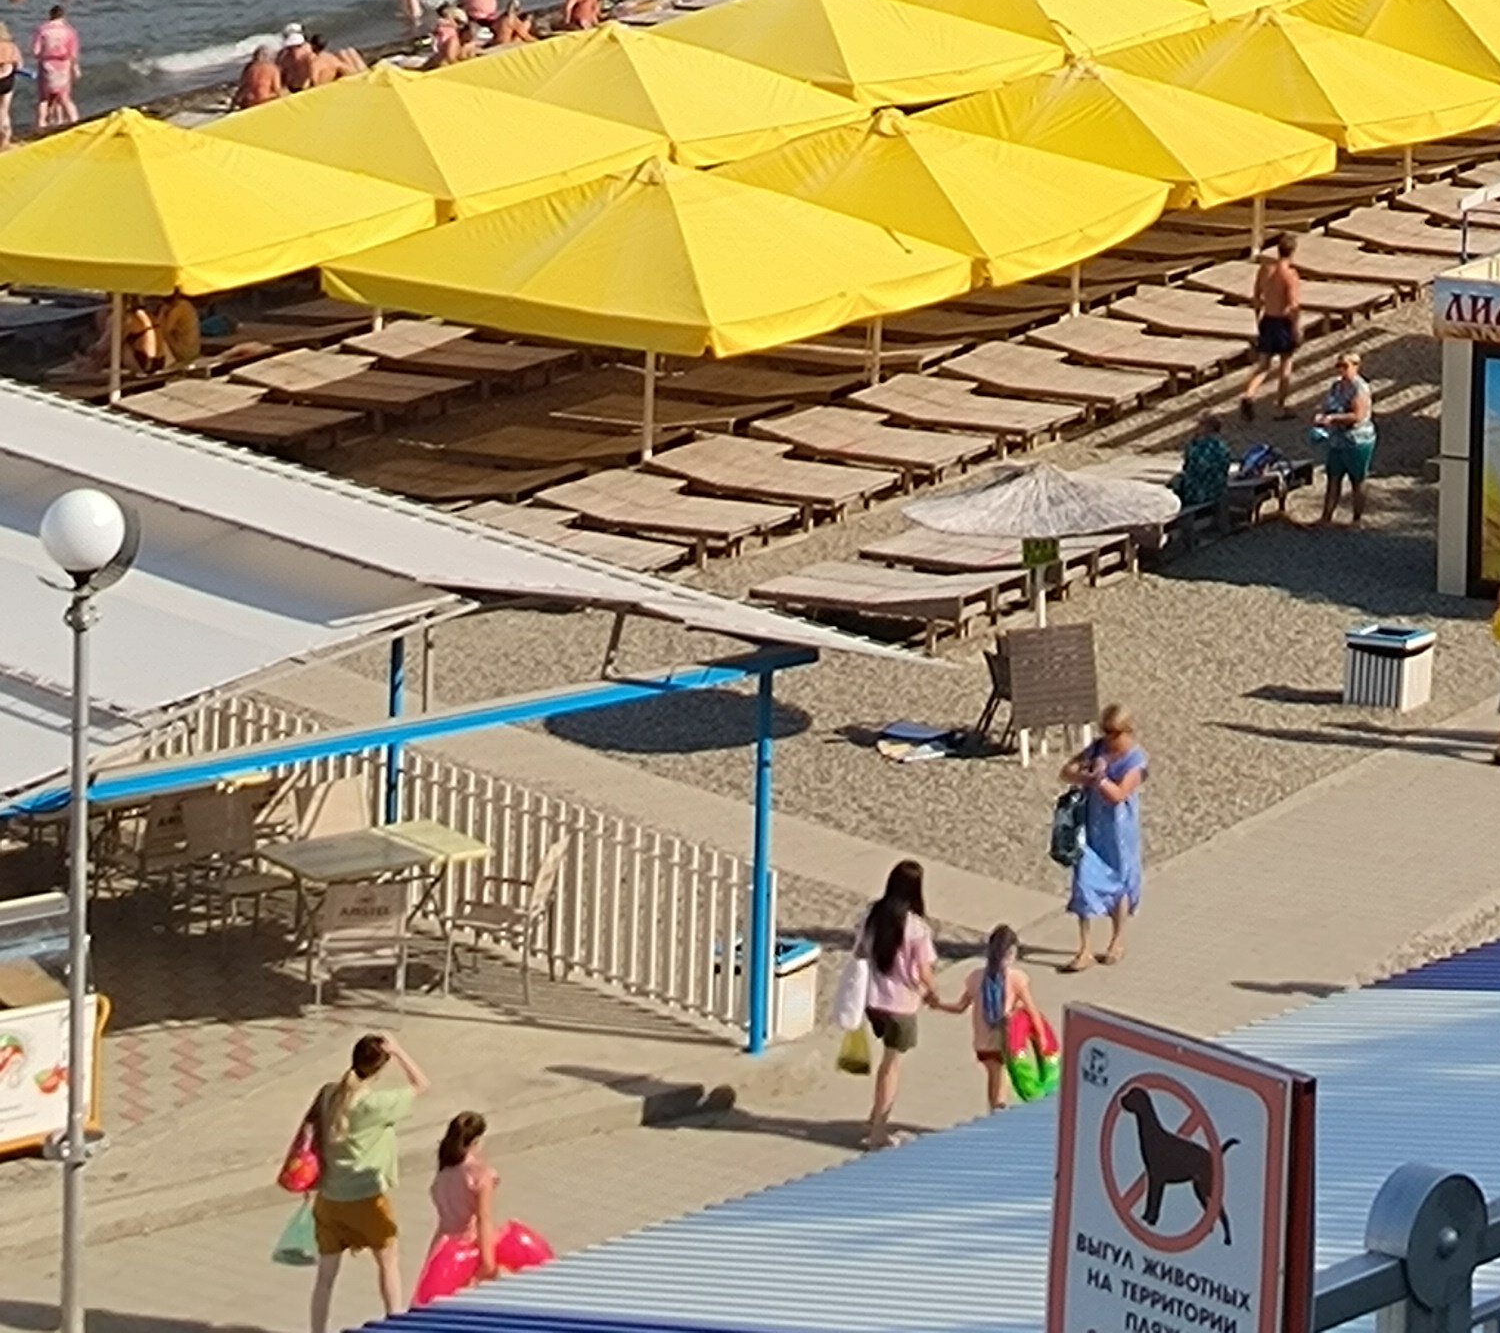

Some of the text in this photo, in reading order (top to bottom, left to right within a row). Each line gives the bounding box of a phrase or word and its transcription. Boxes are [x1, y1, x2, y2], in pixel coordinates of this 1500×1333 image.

[1076, 1233, 1251, 1313] ВЫГУЛ ЖИВОТНЫХ
[1087, 1268, 1238, 1333] НА ТЕРРИТОРИИ
